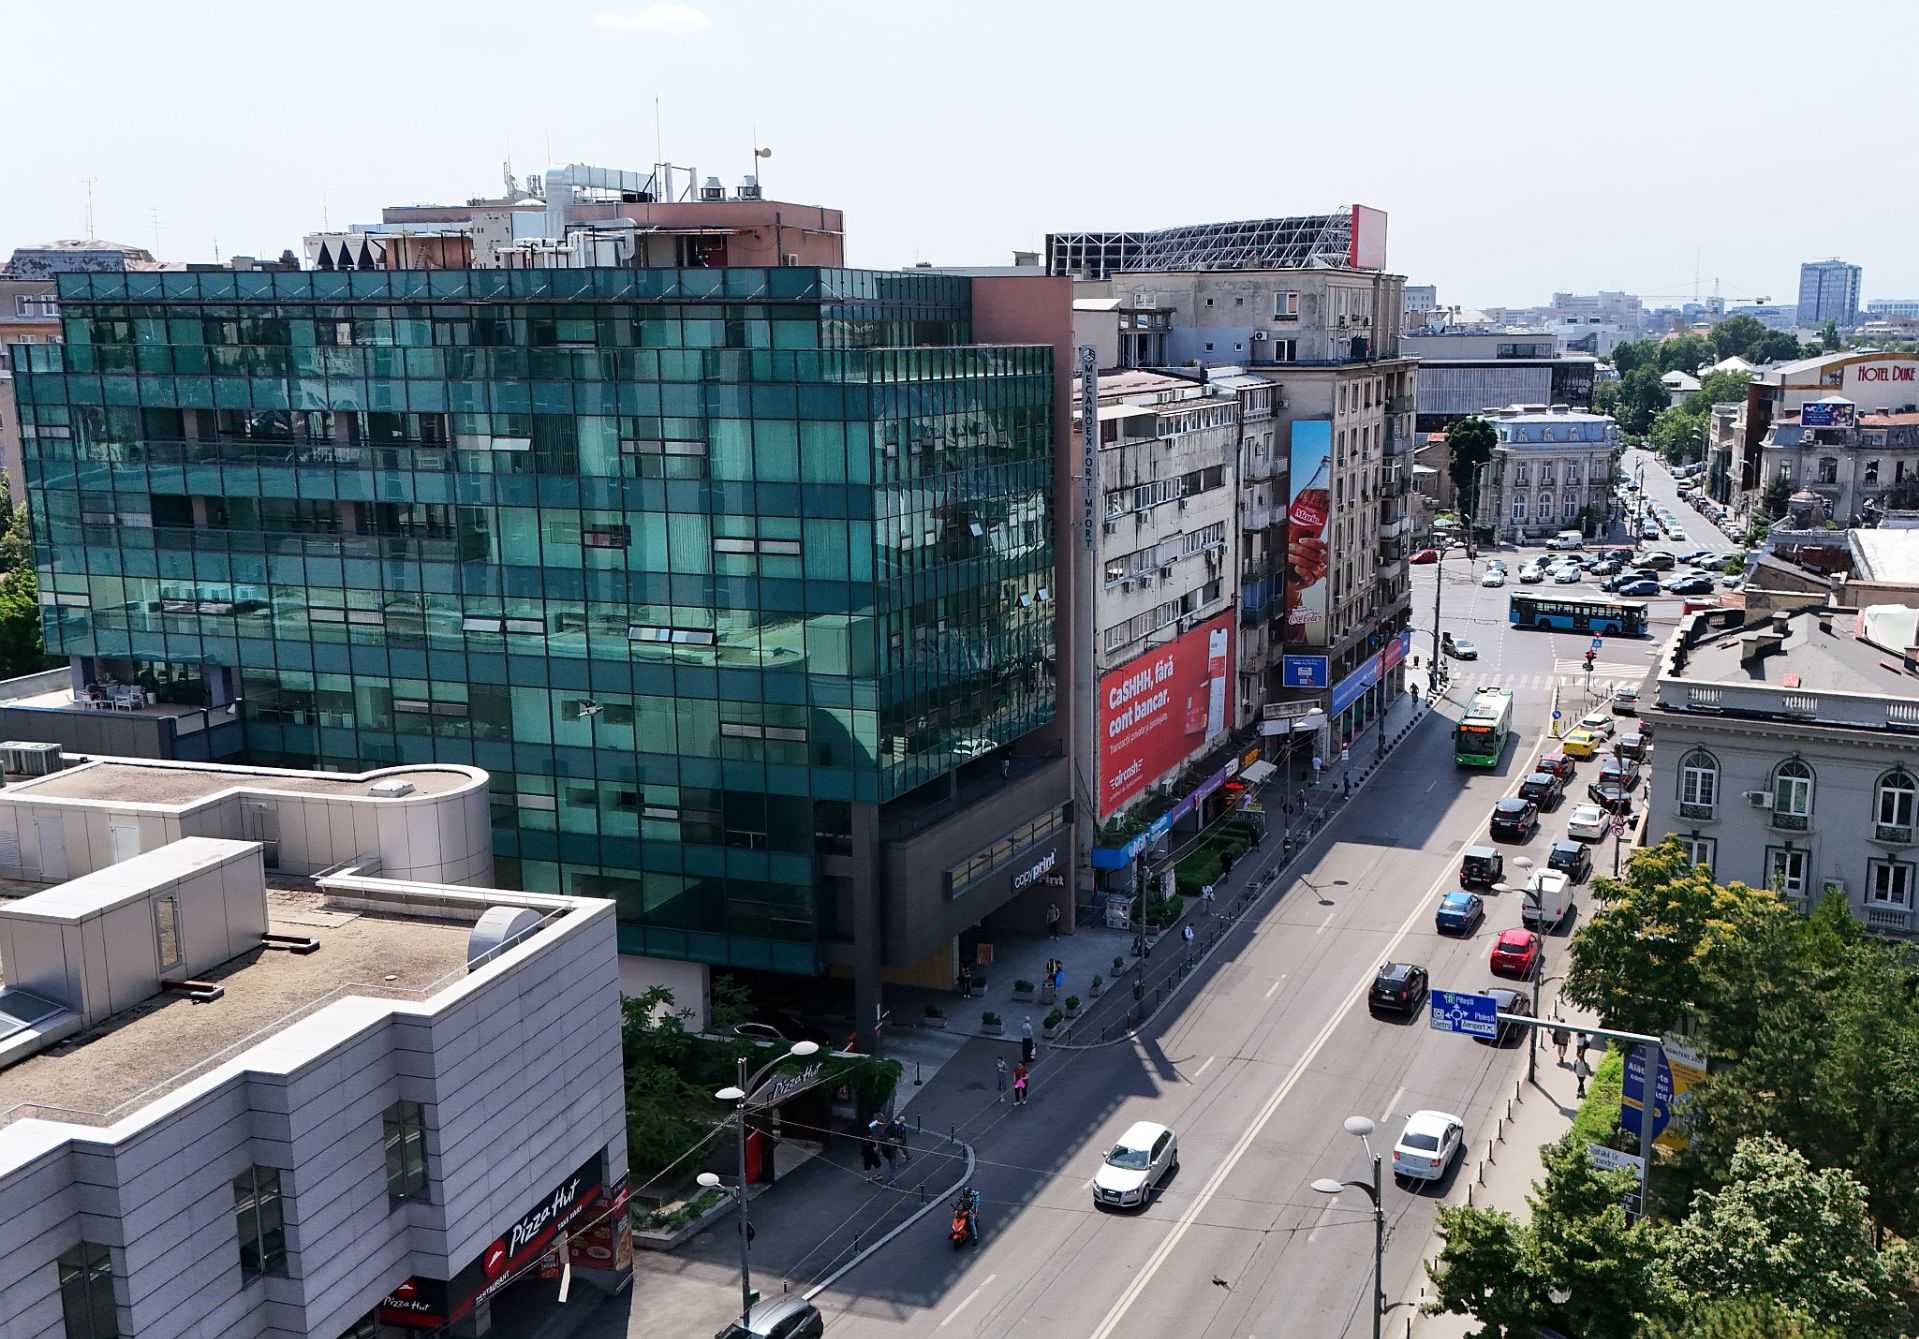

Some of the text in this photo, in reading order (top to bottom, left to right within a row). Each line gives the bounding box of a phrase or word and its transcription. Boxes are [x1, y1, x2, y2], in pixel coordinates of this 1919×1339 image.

[1858, 365, 1916, 381] HOTEL DUKE
[1109, 655, 1174, 710] CaSHHH, fără
[1109, 688, 1170, 738] cont bancar.
[1113, 759, 1140, 788] aircash
[1014, 850, 1056, 889] copyprint
[773, 1061, 824, 1100] Pizza Hut
[510, 1204, 551, 1258] Pizza
[552, 1178, 581, 1218] Hut
[557, 1215, 570, 1231] TAKE
[383, 1296, 431, 1311] Pizza Hut
[475, 1270, 511, 1306] RESTAURANT
